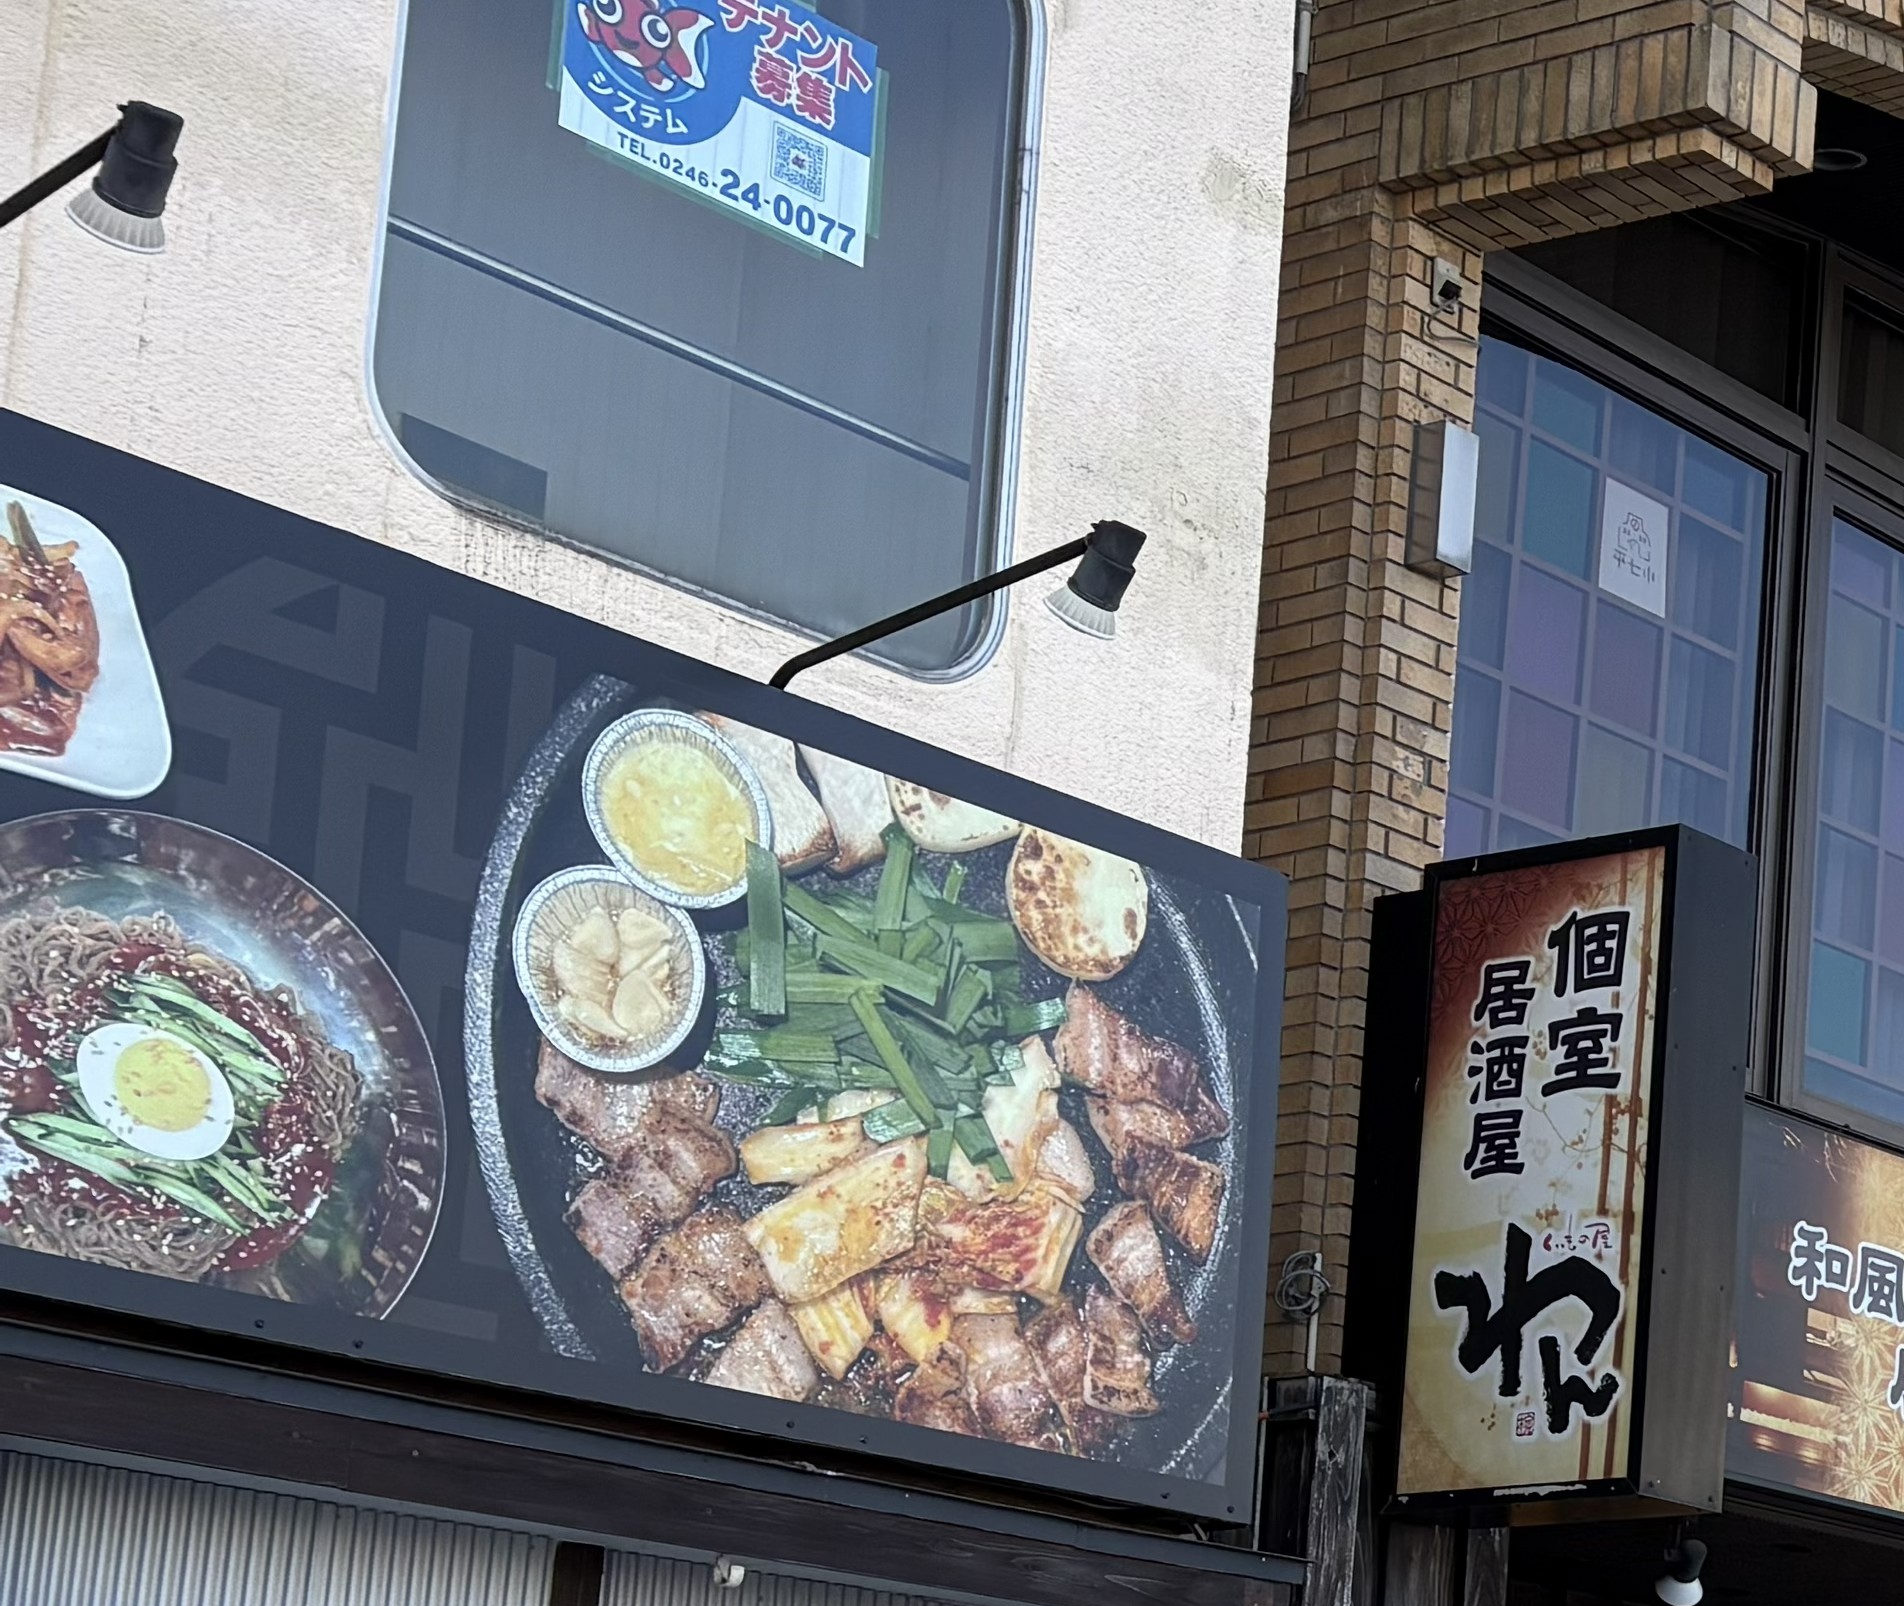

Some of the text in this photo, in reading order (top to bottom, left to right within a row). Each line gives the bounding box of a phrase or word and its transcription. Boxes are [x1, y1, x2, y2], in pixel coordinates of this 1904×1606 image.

[587, 71, 688, 135] システム
[750, 46, 836, 131] 募集
[616, 131, 857, 254] TEL.0246-24-0077
[1463, 959, 1537, 1181] 居酒屋
[1540, 909, 1632, 1099] 個室
[1433, 1222, 1621, 1435] わん
